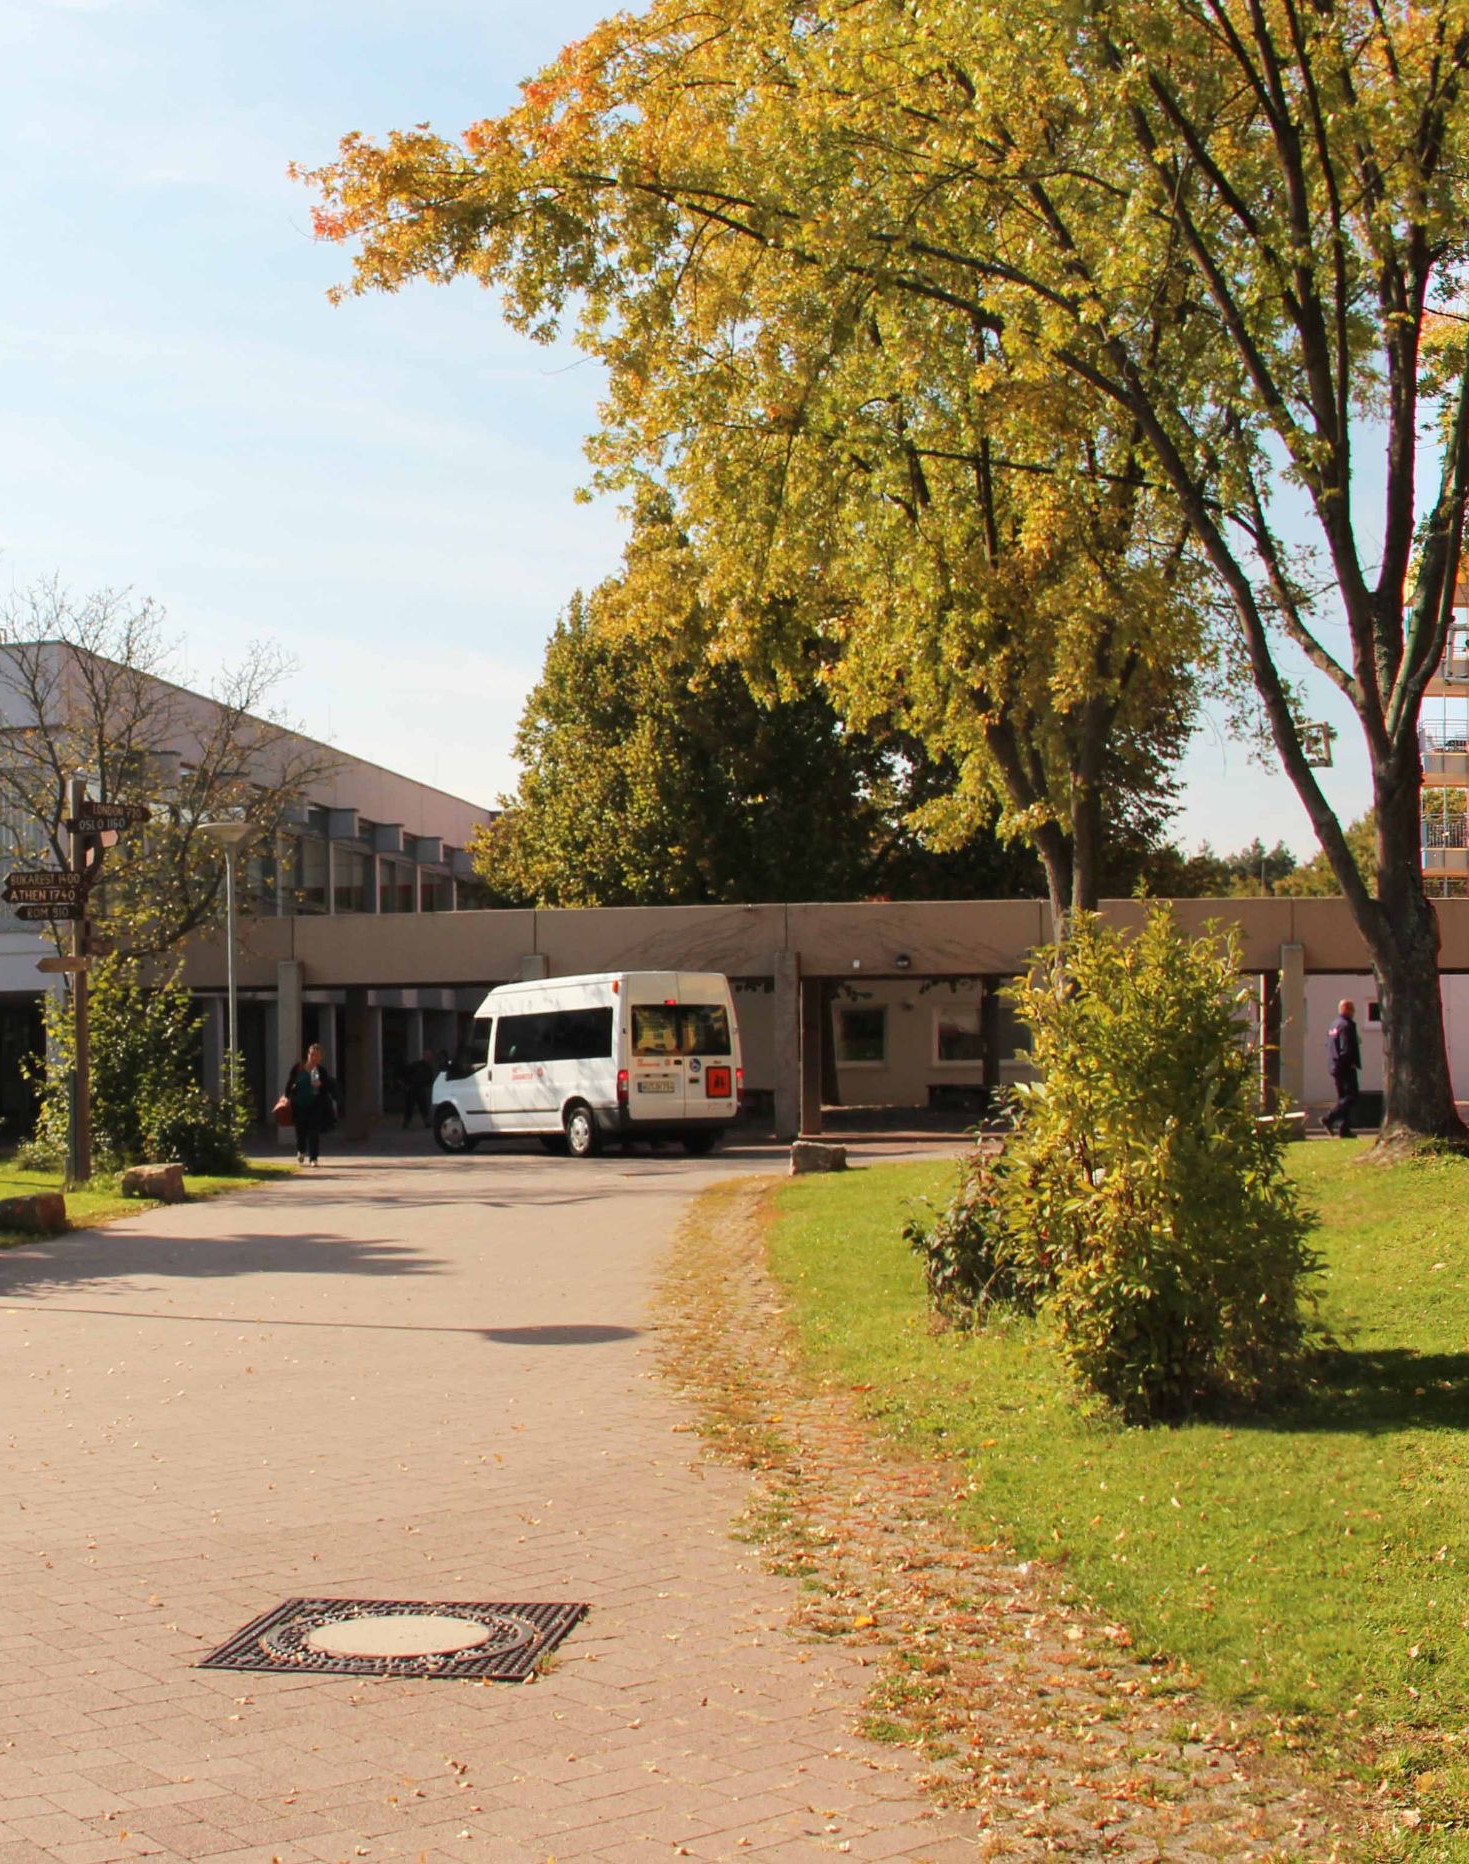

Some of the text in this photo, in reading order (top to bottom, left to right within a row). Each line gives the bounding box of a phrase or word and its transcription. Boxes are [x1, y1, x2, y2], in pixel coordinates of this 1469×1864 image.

[92, 803, 124, 816] LONDON
[79, 817, 126, 830] OSLO 1160
[10, 873, 81, 886] BUKAREST 1400
[10, 889, 76, 901] ATHEN 1740
[27, 907, 49, 918] ROM
